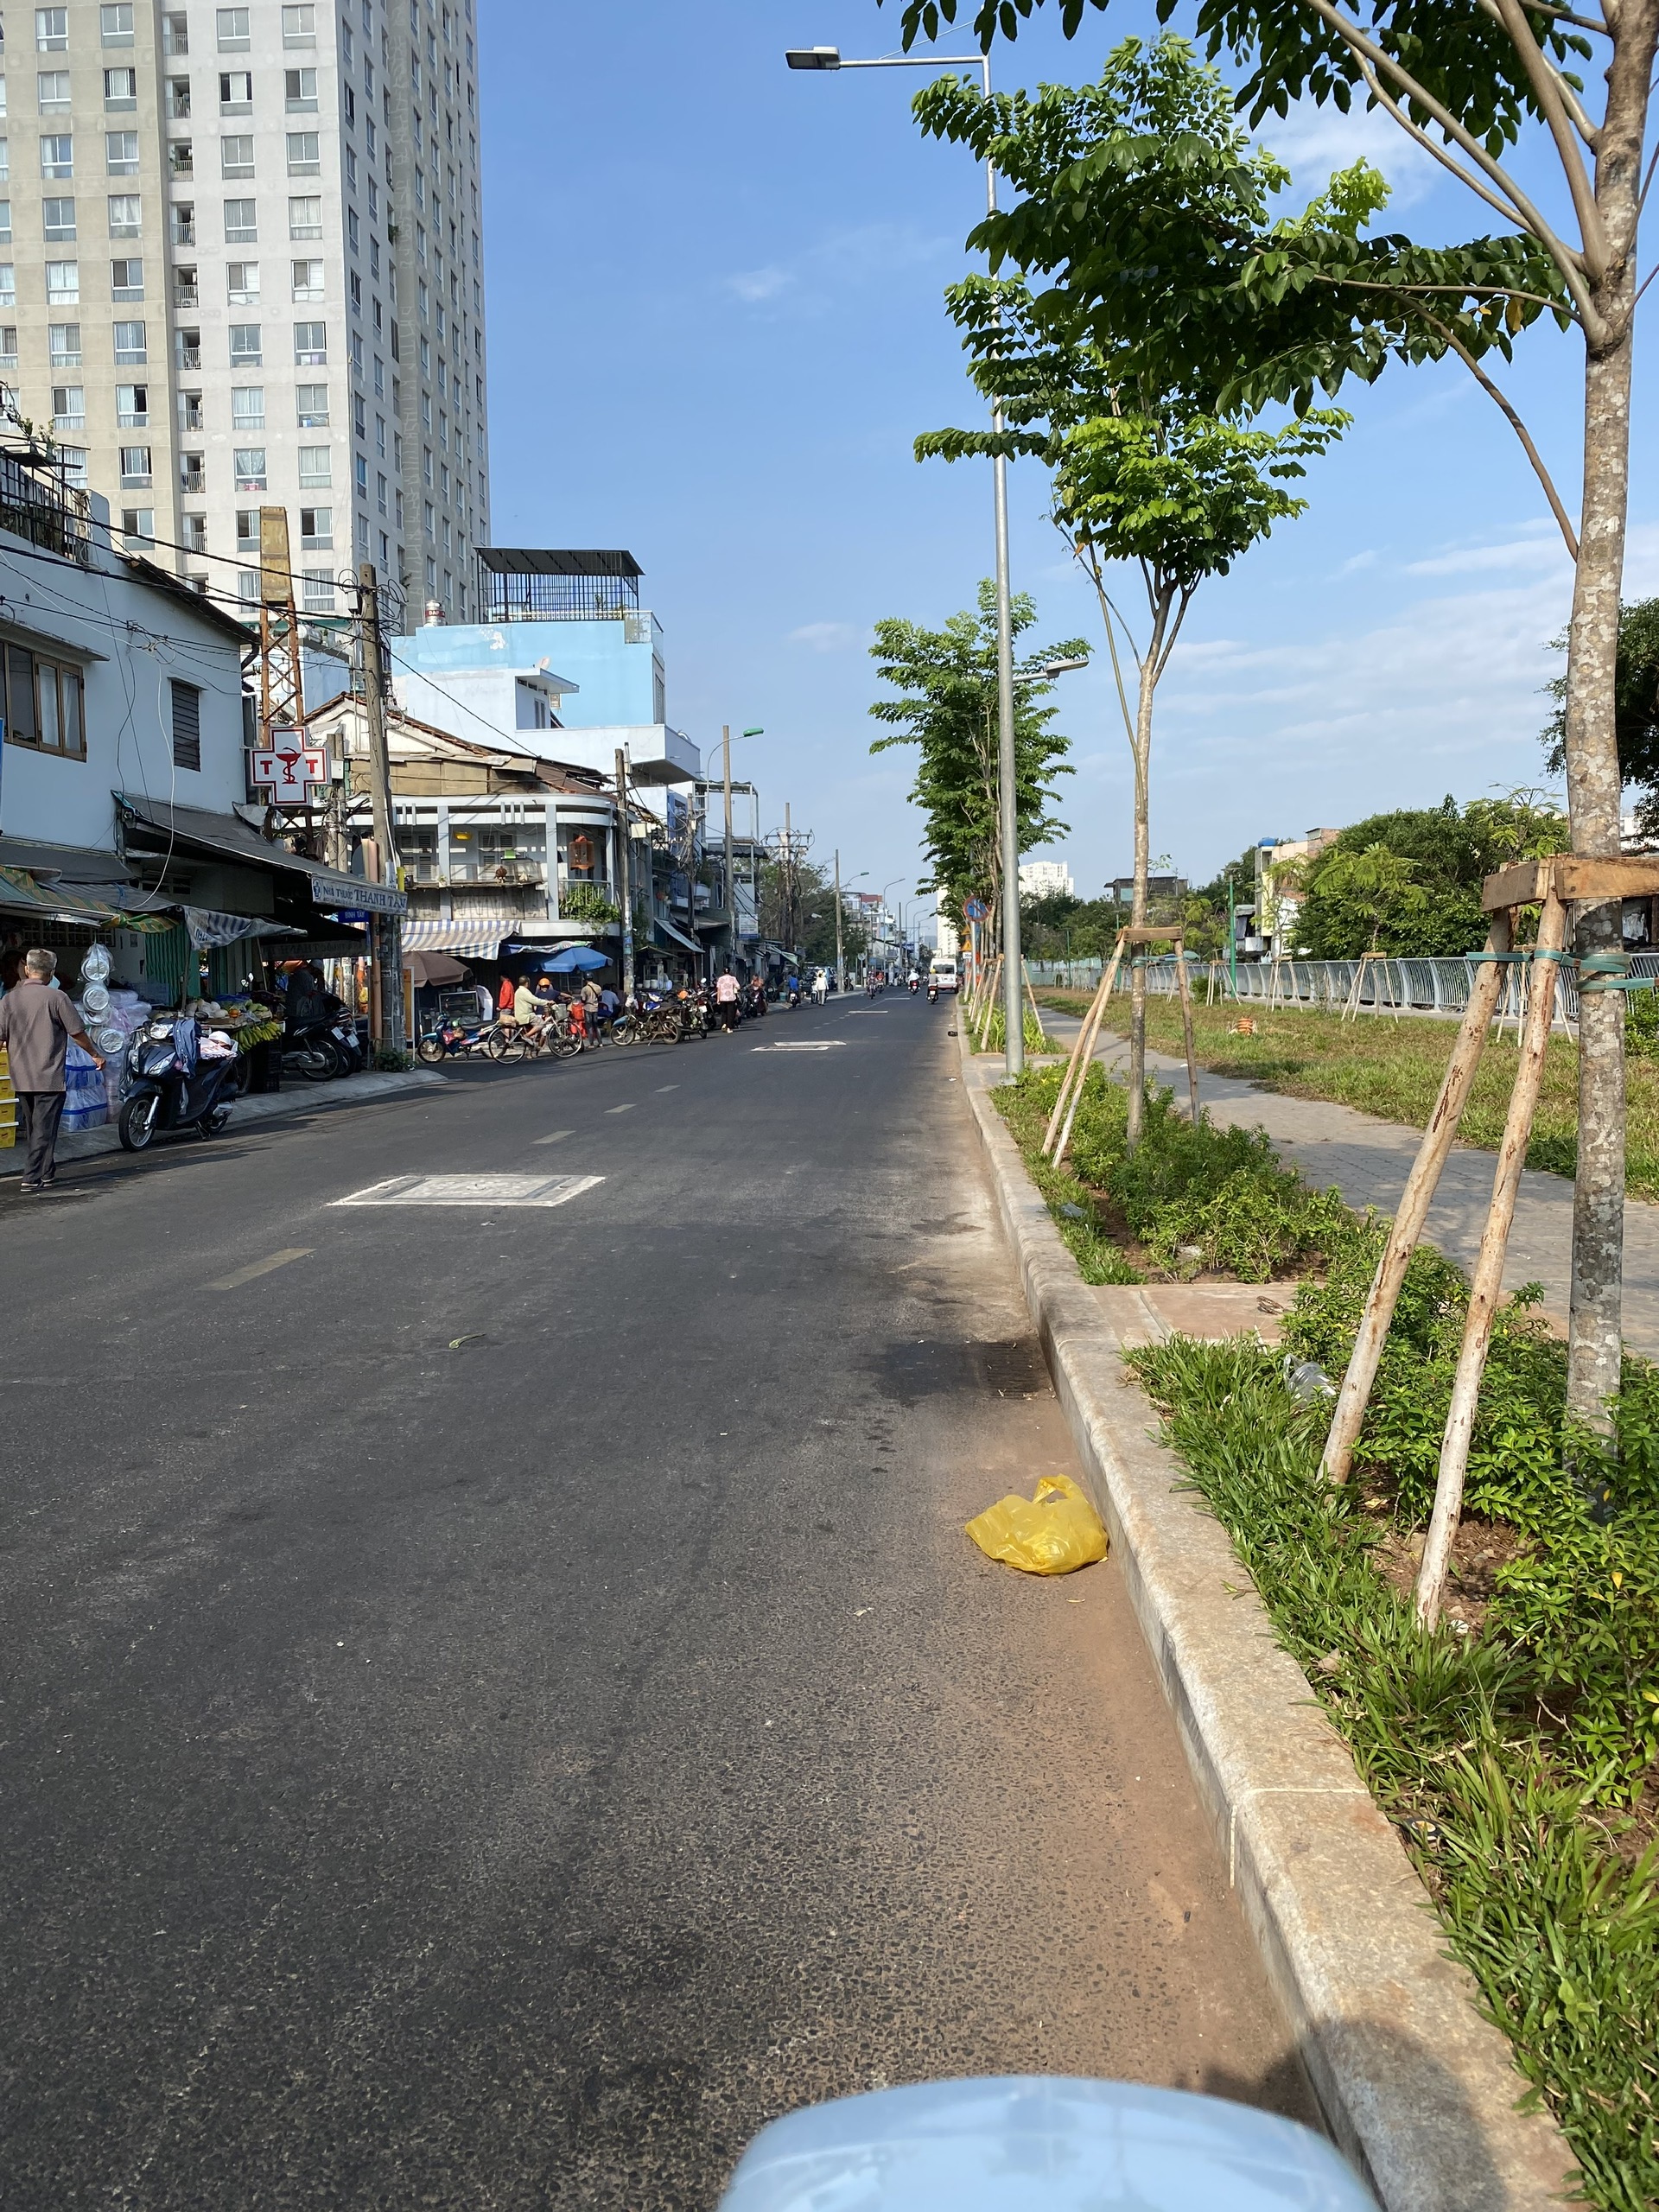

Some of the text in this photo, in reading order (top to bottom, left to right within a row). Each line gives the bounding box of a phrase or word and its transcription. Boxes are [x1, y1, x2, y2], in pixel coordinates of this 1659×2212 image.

[260, 760, 319, 775] T T
[353, 889, 386, 906] THANH
